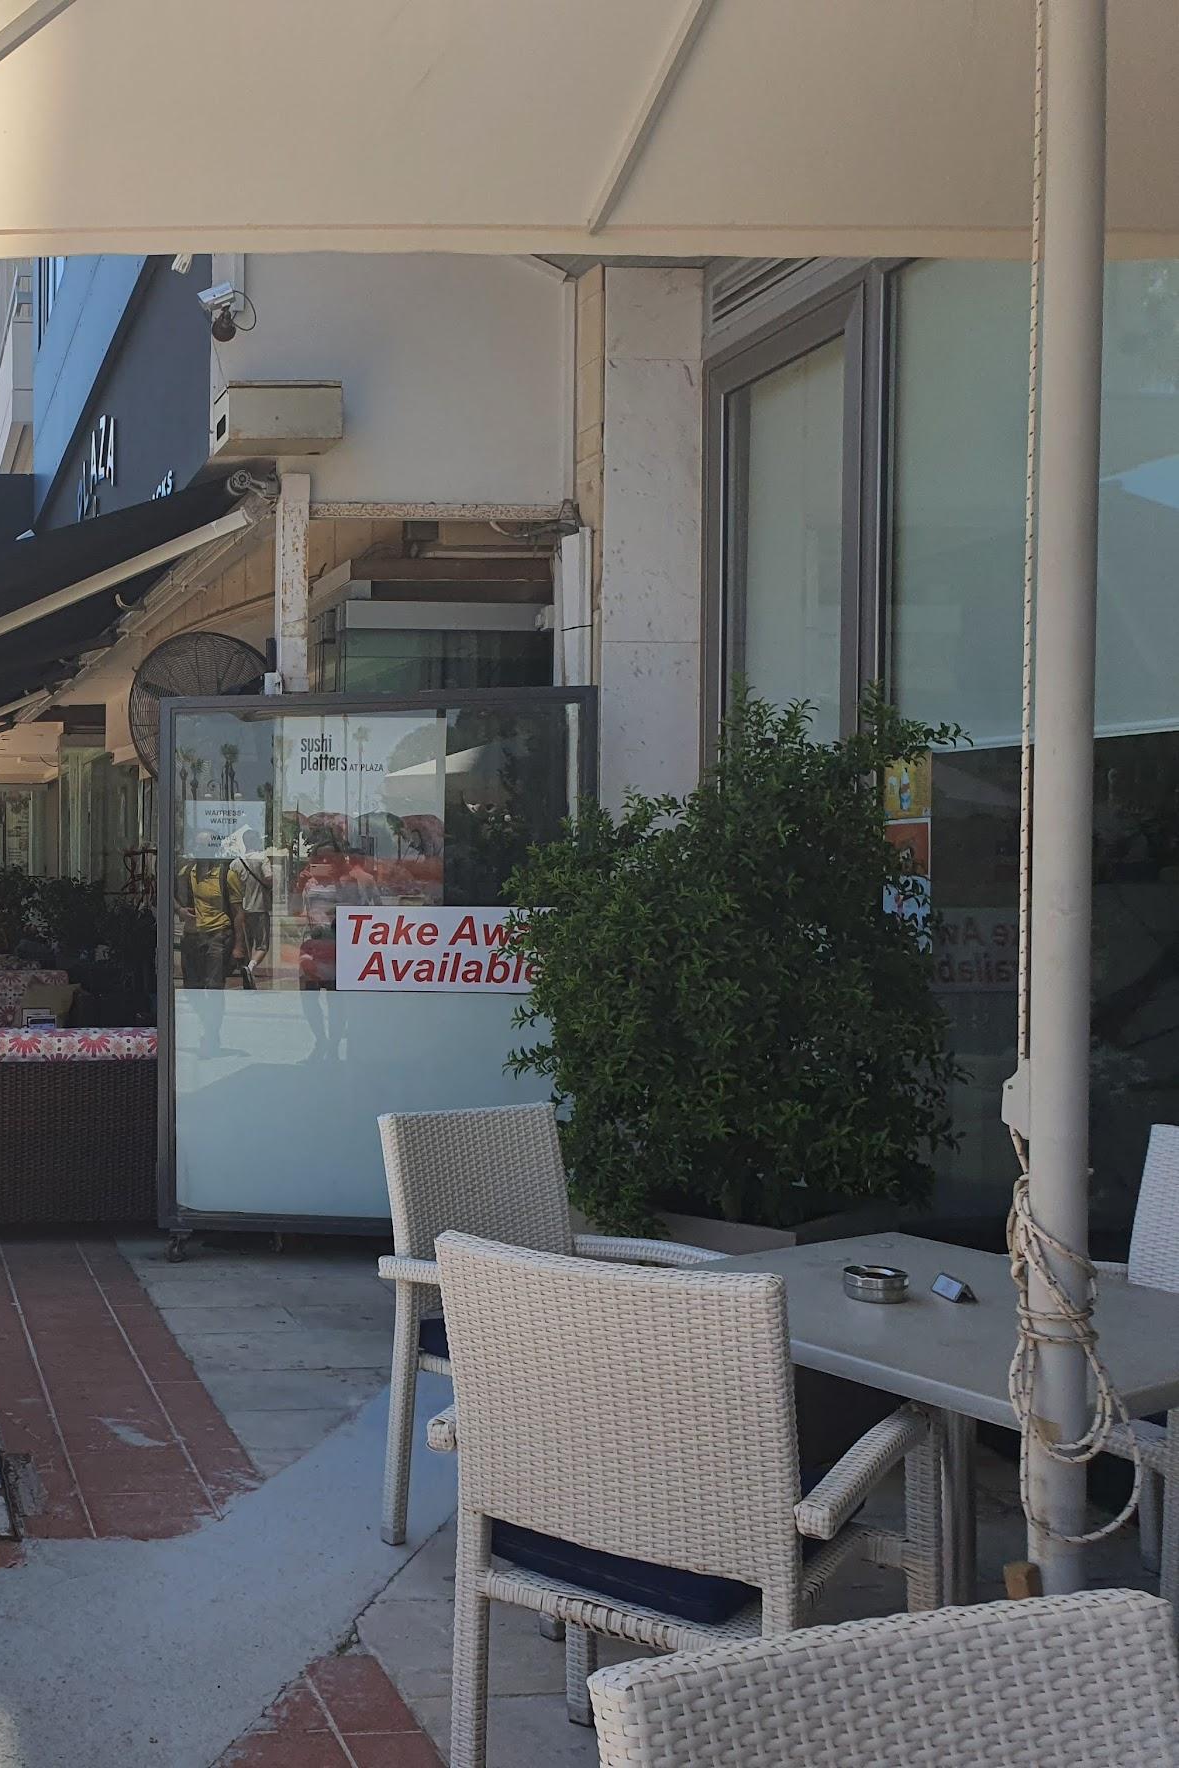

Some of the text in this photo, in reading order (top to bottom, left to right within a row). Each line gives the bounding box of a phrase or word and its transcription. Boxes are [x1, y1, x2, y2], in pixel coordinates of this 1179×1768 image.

[77, 414, 115, 523] PLAZA
[301, 733, 332, 753] sushi
[301, 752, 384, 775] platters AT PLAZA
[348, 914, 533, 946] Take Aw
